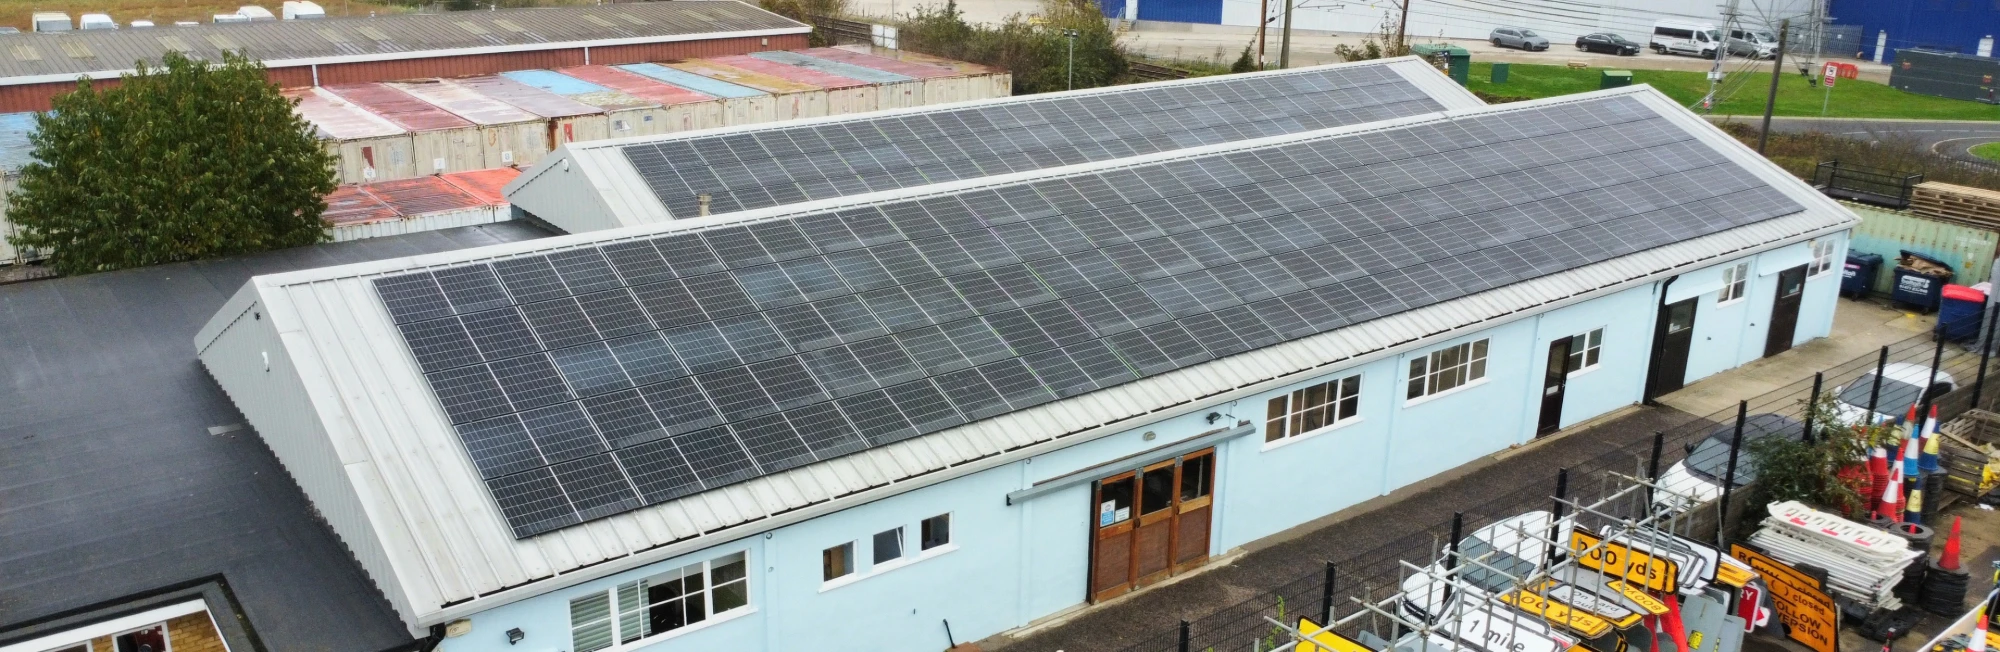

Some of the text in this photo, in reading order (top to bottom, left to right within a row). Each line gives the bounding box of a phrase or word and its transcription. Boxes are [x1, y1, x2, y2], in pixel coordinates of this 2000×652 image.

[1792, 594, 1825, 616] closed
[1469, 619, 1480, 633] 1
[1555, 610, 1593, 627] yds
